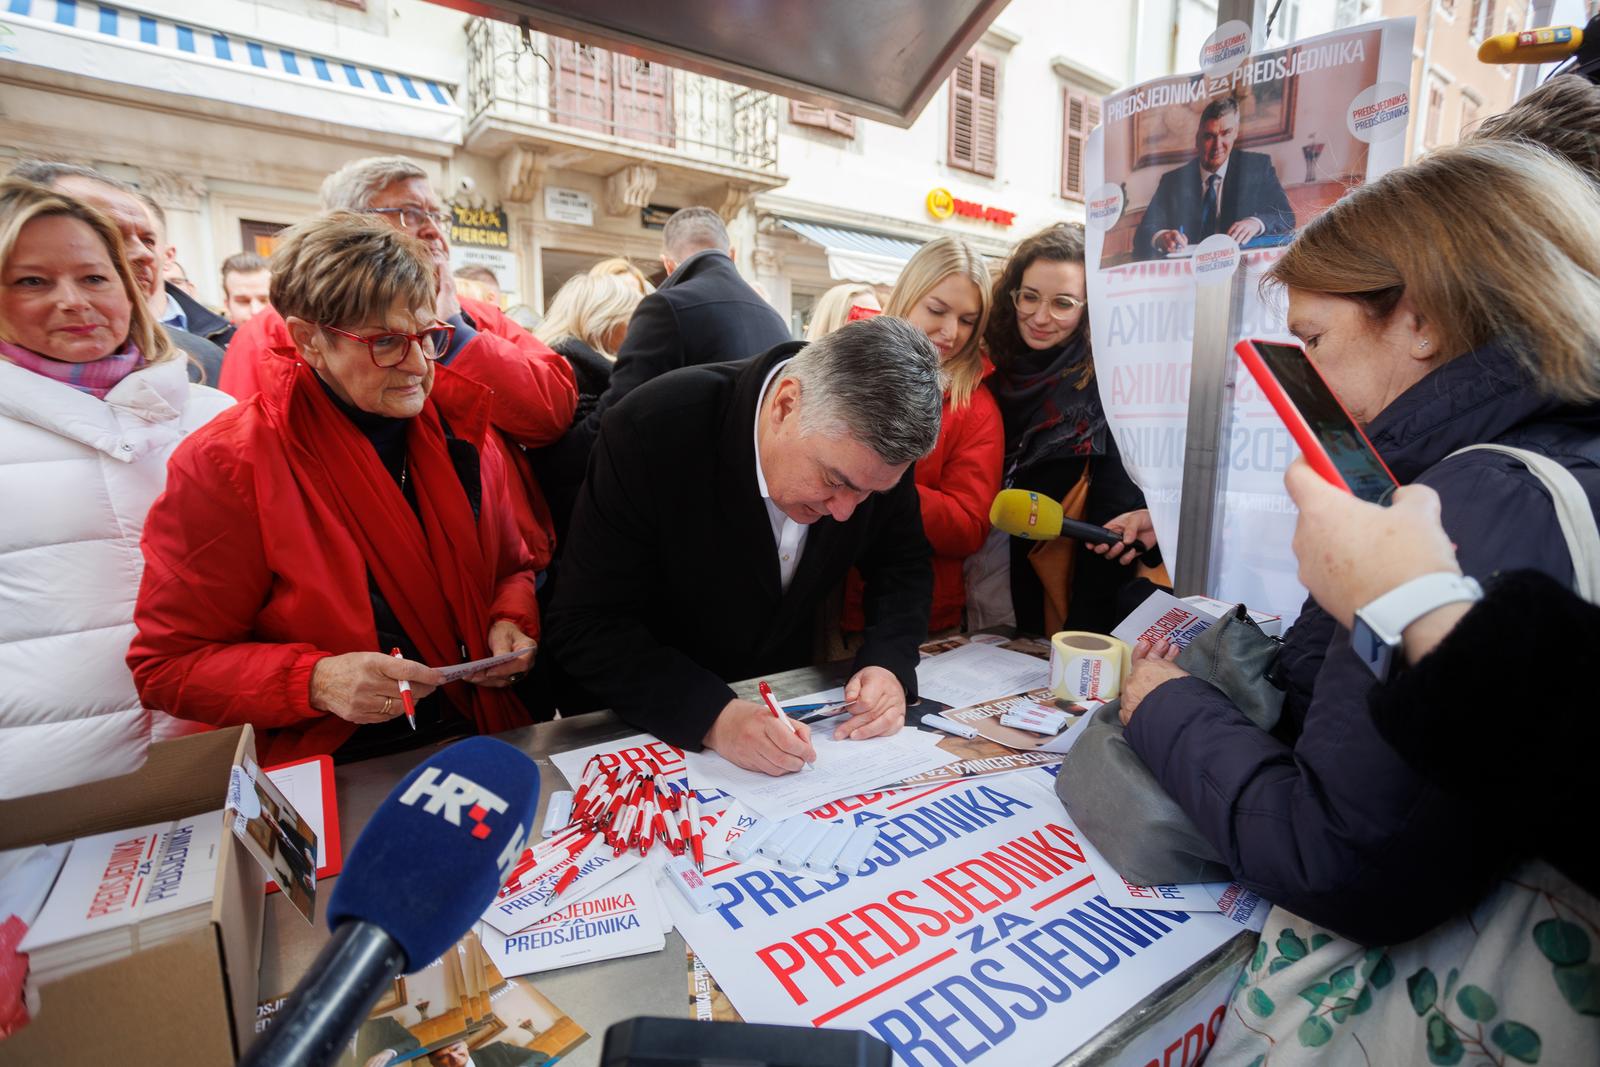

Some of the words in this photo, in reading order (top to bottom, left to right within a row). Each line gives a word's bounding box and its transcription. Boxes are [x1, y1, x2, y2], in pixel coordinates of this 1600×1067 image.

[1522, 30, 1571, 44] RTL
[1107, 76, 1207, 124] PREDSJEDNIKA
[1208, 76, 1231, 98] ZA
[1231, 38, 1366, 90] PREDSJEDNIKA
[1352, 92, 1409, 119] PREDSJEDNIKA
[1354, 104, 1410, 132] PREDSJEDNIKA
[451, 226, 509, 248] PIERCING
[399, 766, 510, 840] HRT
[86, 835, 148, 920] PREDSJEDNIKA
[137, 860, 153, 879] ZA
[500, 854, 611, 915] PREDSJNIKA
[504, 913, 641, 956] PREDSJEDNIKA
[560, 917, 586, 928] ZA
[755, 822, 1088, 1006] PREDSJEDNIKA
[956, 911, 1036, 956] ZA
